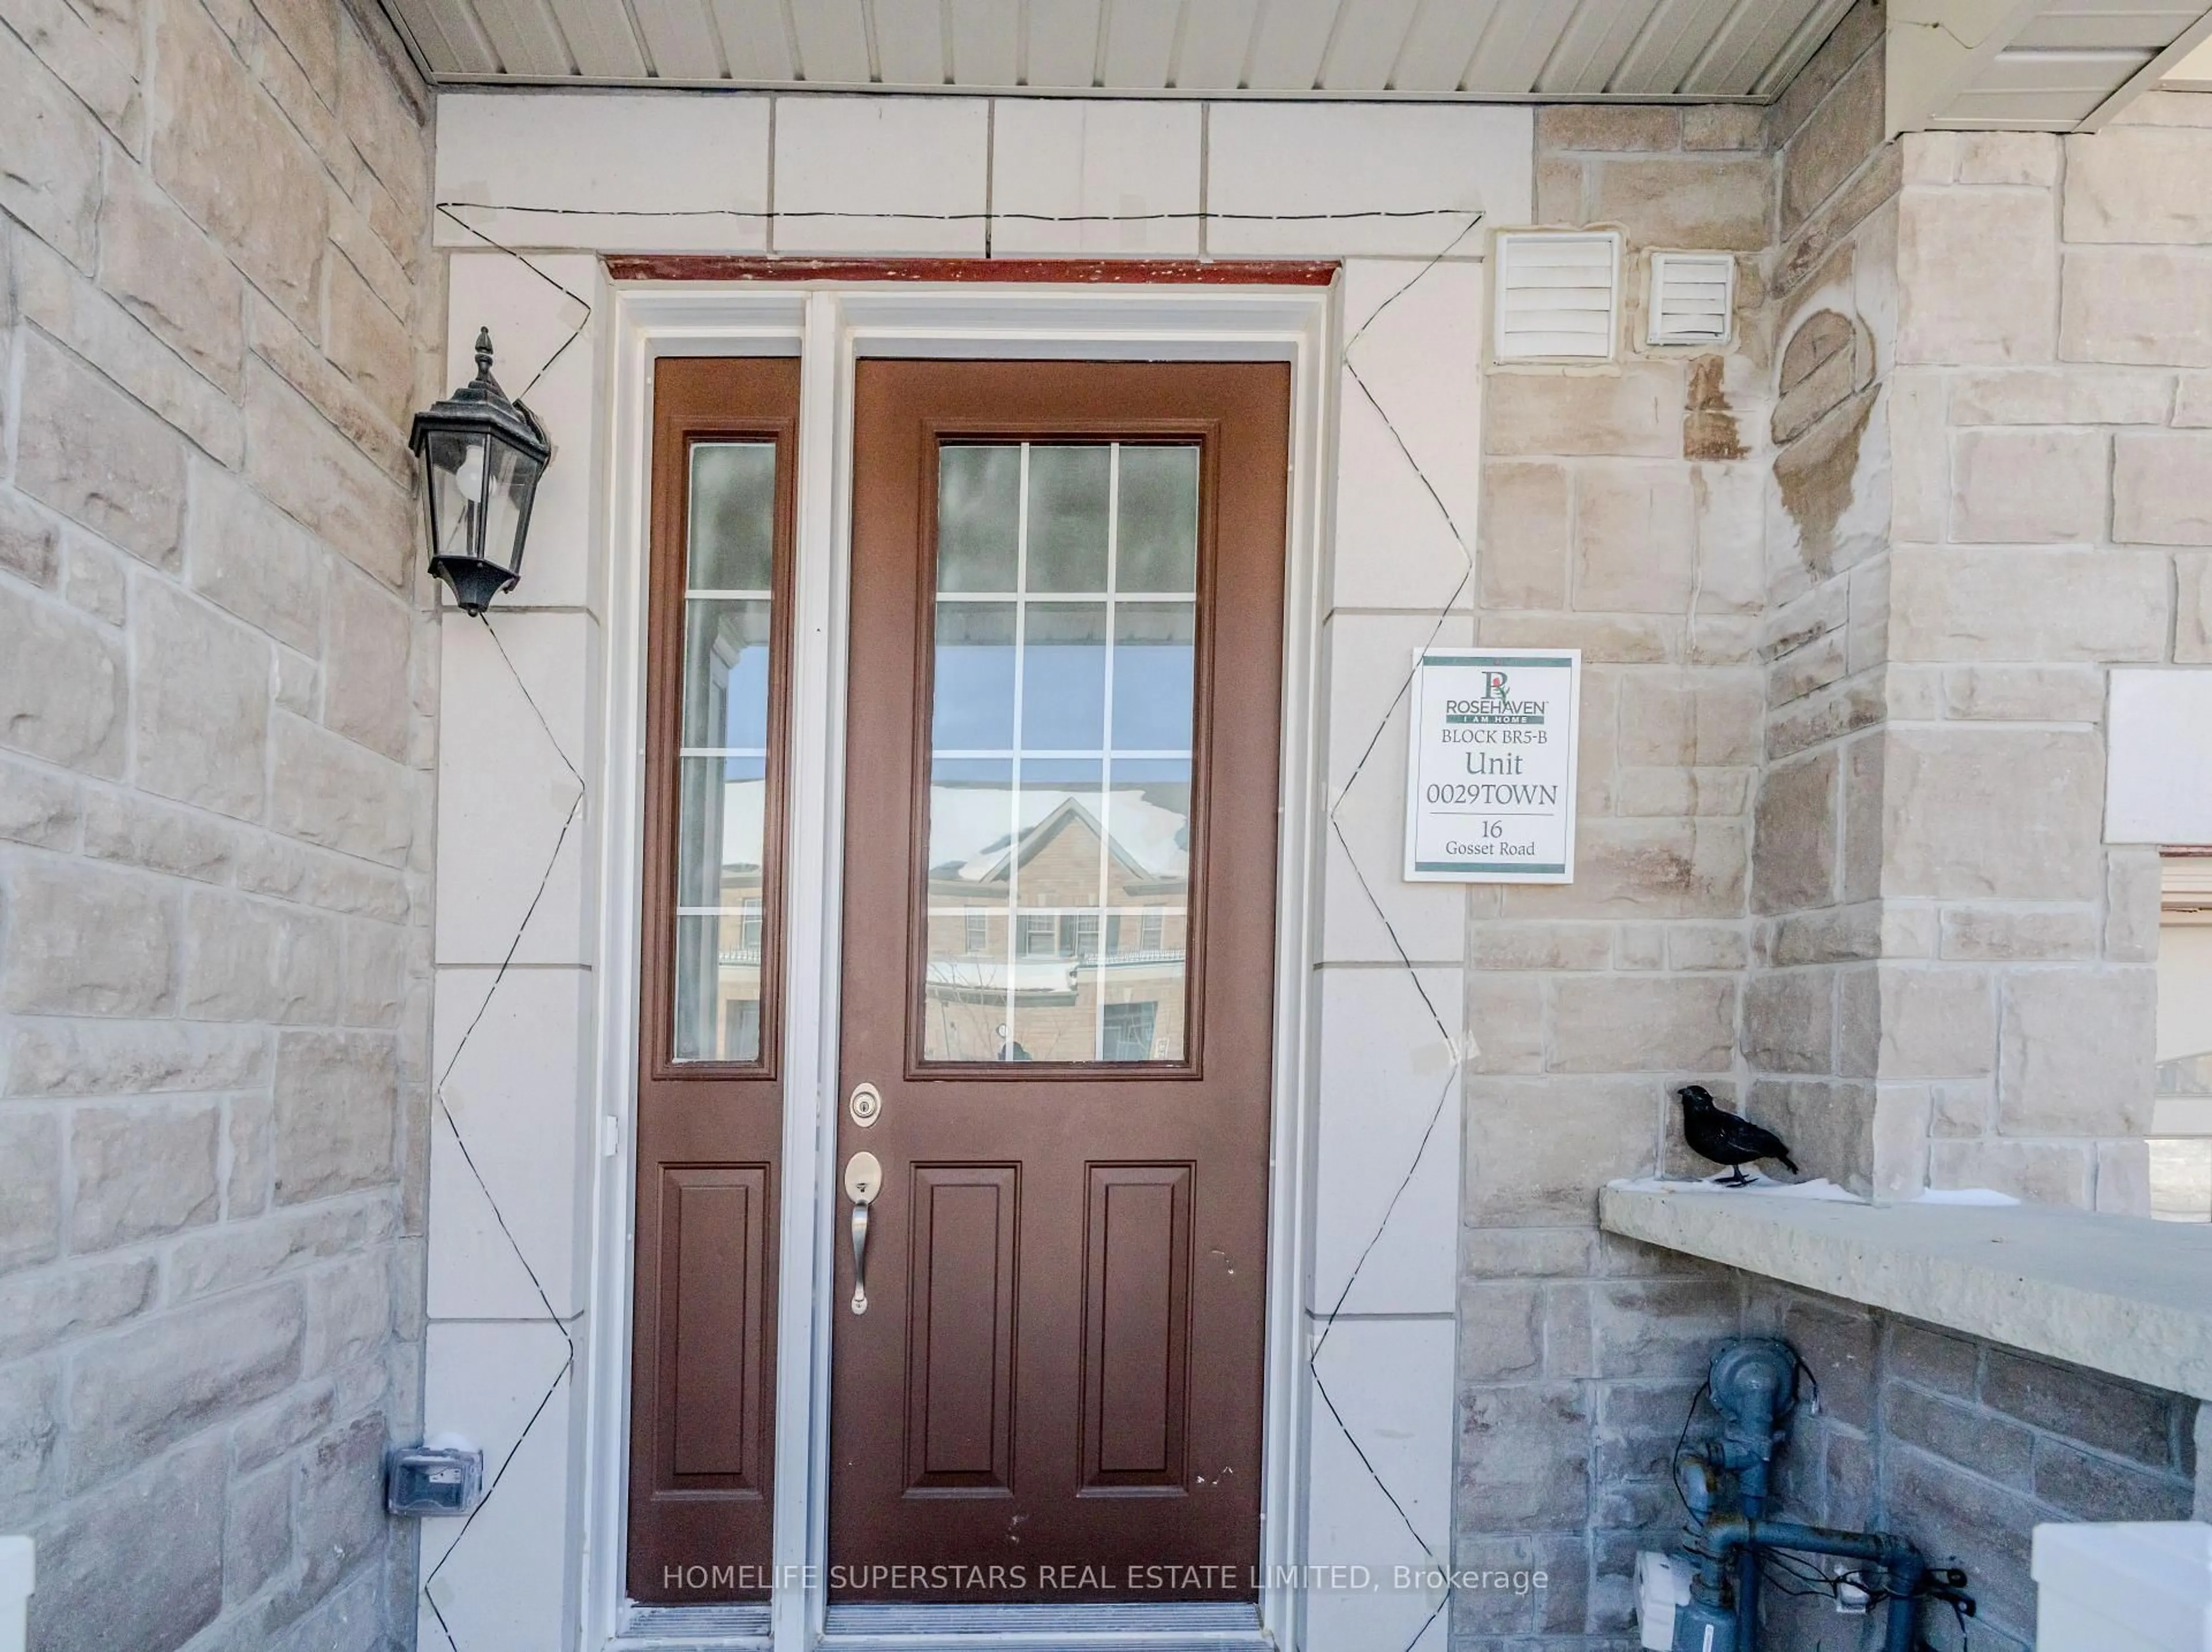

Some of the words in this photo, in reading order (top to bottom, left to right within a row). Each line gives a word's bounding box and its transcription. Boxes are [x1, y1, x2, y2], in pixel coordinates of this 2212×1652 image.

[1446, 700, 1545, 714] ROSEHAVEN
[1442, 729, 1497, 743] BLOCK
[1502, 730, 1548, 744] BR5-B
[1465, 752, 1523, 775] Unit
[1427, 783, 1558, 805] 0029TOWN
[1482, 820, 1502, 839] 16
[1445, 840, 1495, 855] Gosset
[1499, 841, 1535, 856] Road
